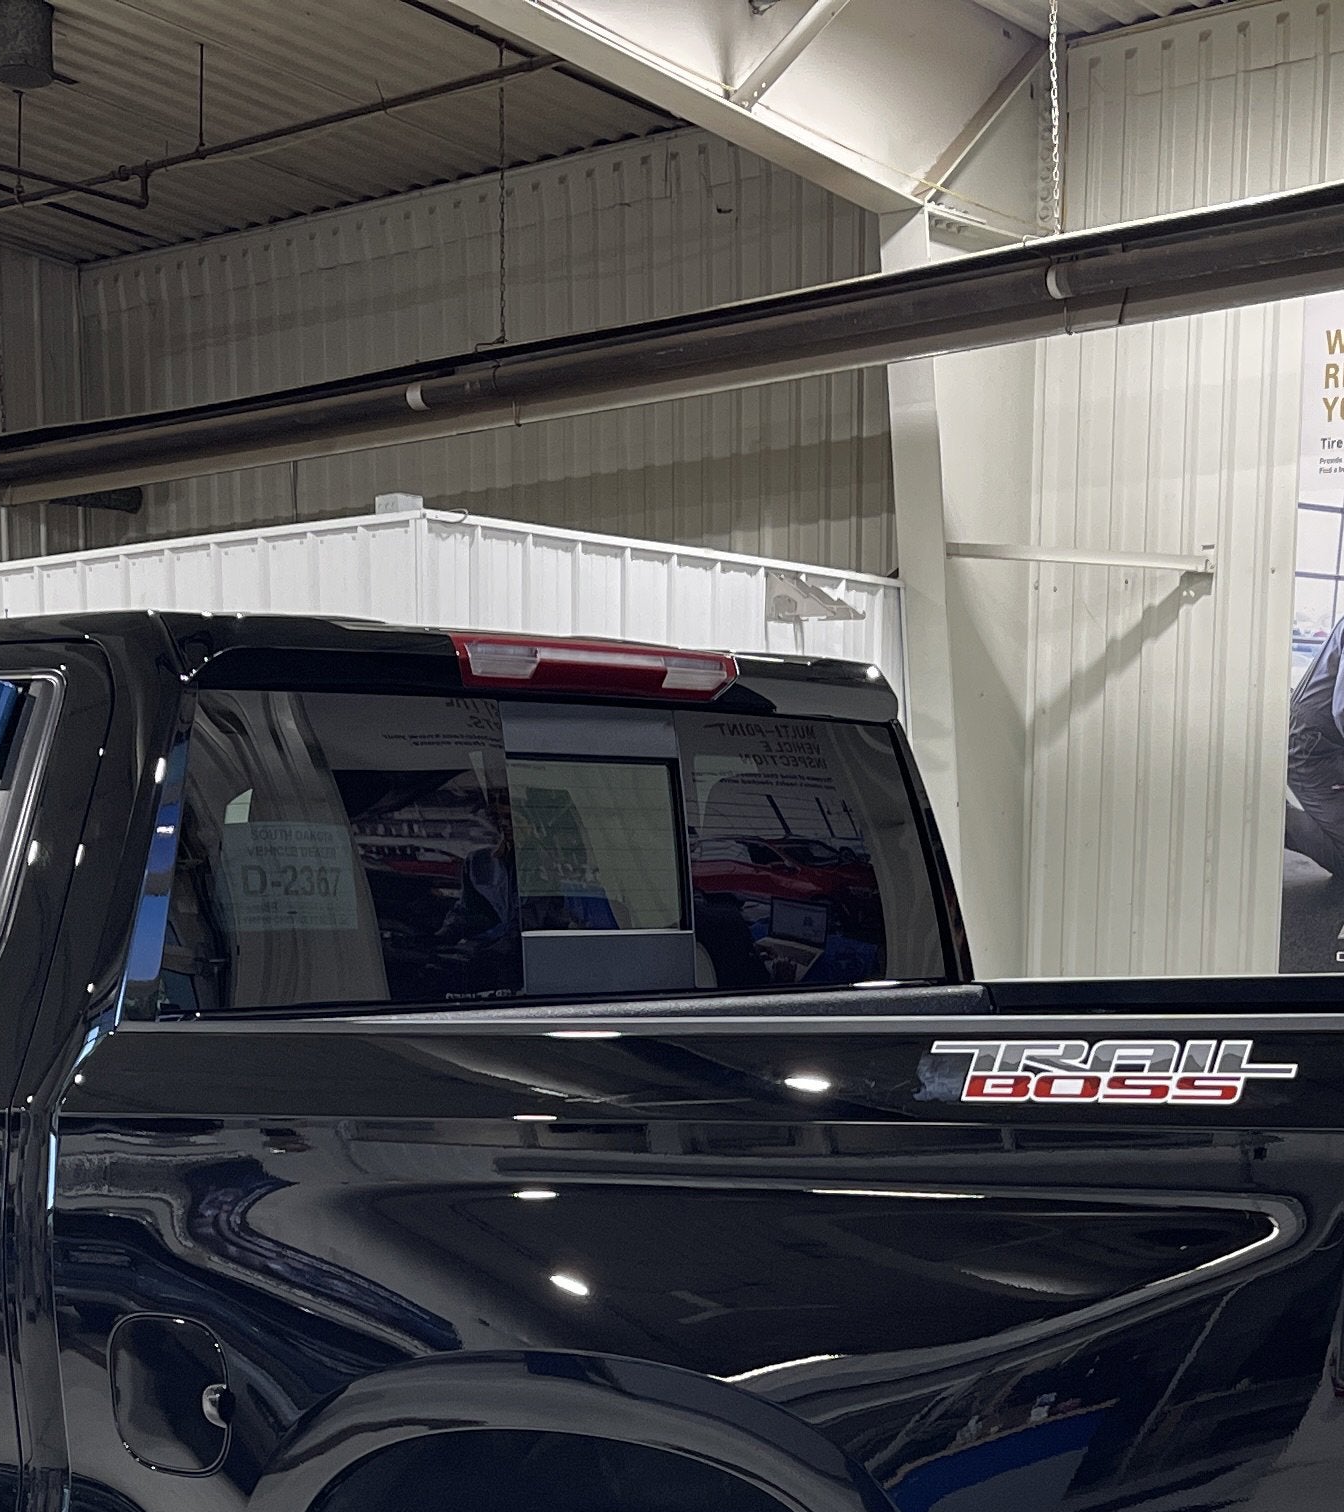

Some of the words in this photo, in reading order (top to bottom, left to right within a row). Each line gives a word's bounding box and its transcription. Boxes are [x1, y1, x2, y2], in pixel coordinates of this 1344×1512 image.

[1320, 437, 1343, 450] Tire
[930, 1039, 1299, 1078] TRAIL
[961, 1074, 1246, 1105] BOSS
